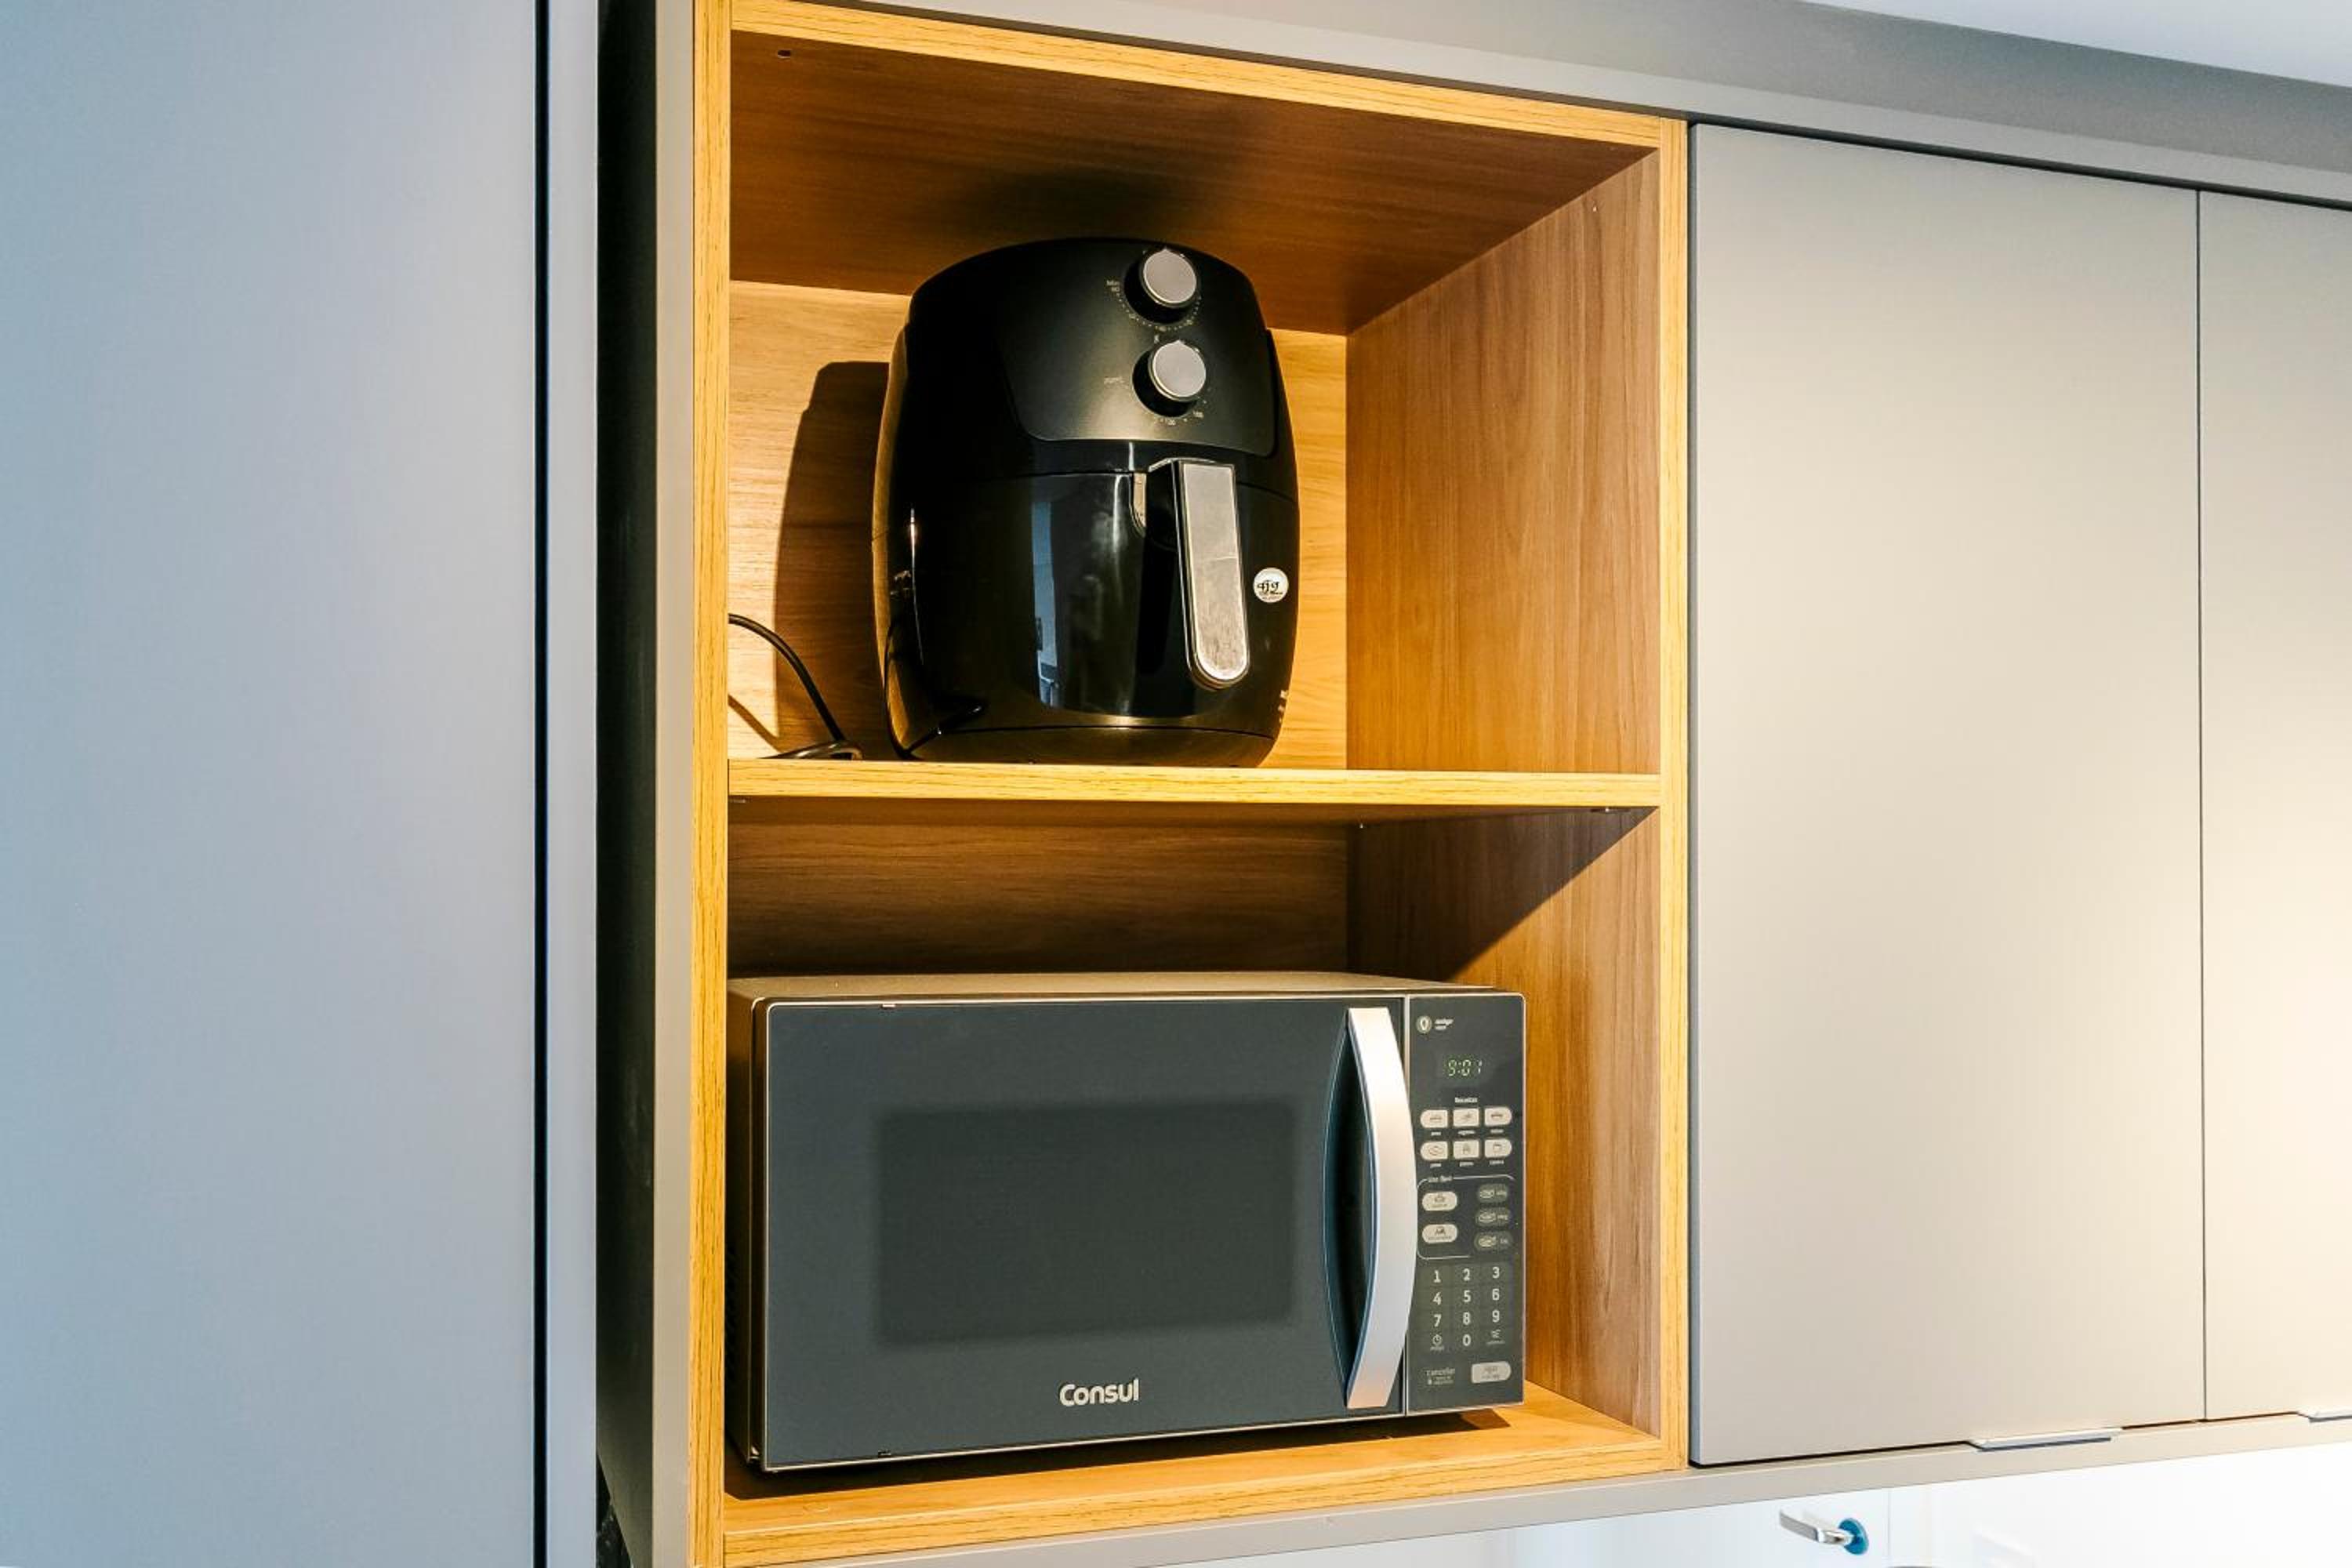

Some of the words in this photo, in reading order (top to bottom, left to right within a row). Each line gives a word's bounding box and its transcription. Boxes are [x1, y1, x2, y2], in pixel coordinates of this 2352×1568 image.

[1448, 1059, 1483, 1076] 9:01
[1433, 1269, 1441, 1283] 1
[1462, 1268, 1471, 1281] 2
[1492, 1266, 1500, 1279] 3
[1432, 1291, 1442, 1305] 4
[1463, 1290, 1472, 1303] 5
[1492, 1288, 1500, 1301] 6
[1433, 1313, 1442, 1327] 7
[1462, 1312, 1471, 1325] 8
[1492, 1309, 1500, 1323] 9
[1462, 1334, 1472, 1346] 0
[1059, 1377, 1139, 1407] Consul
